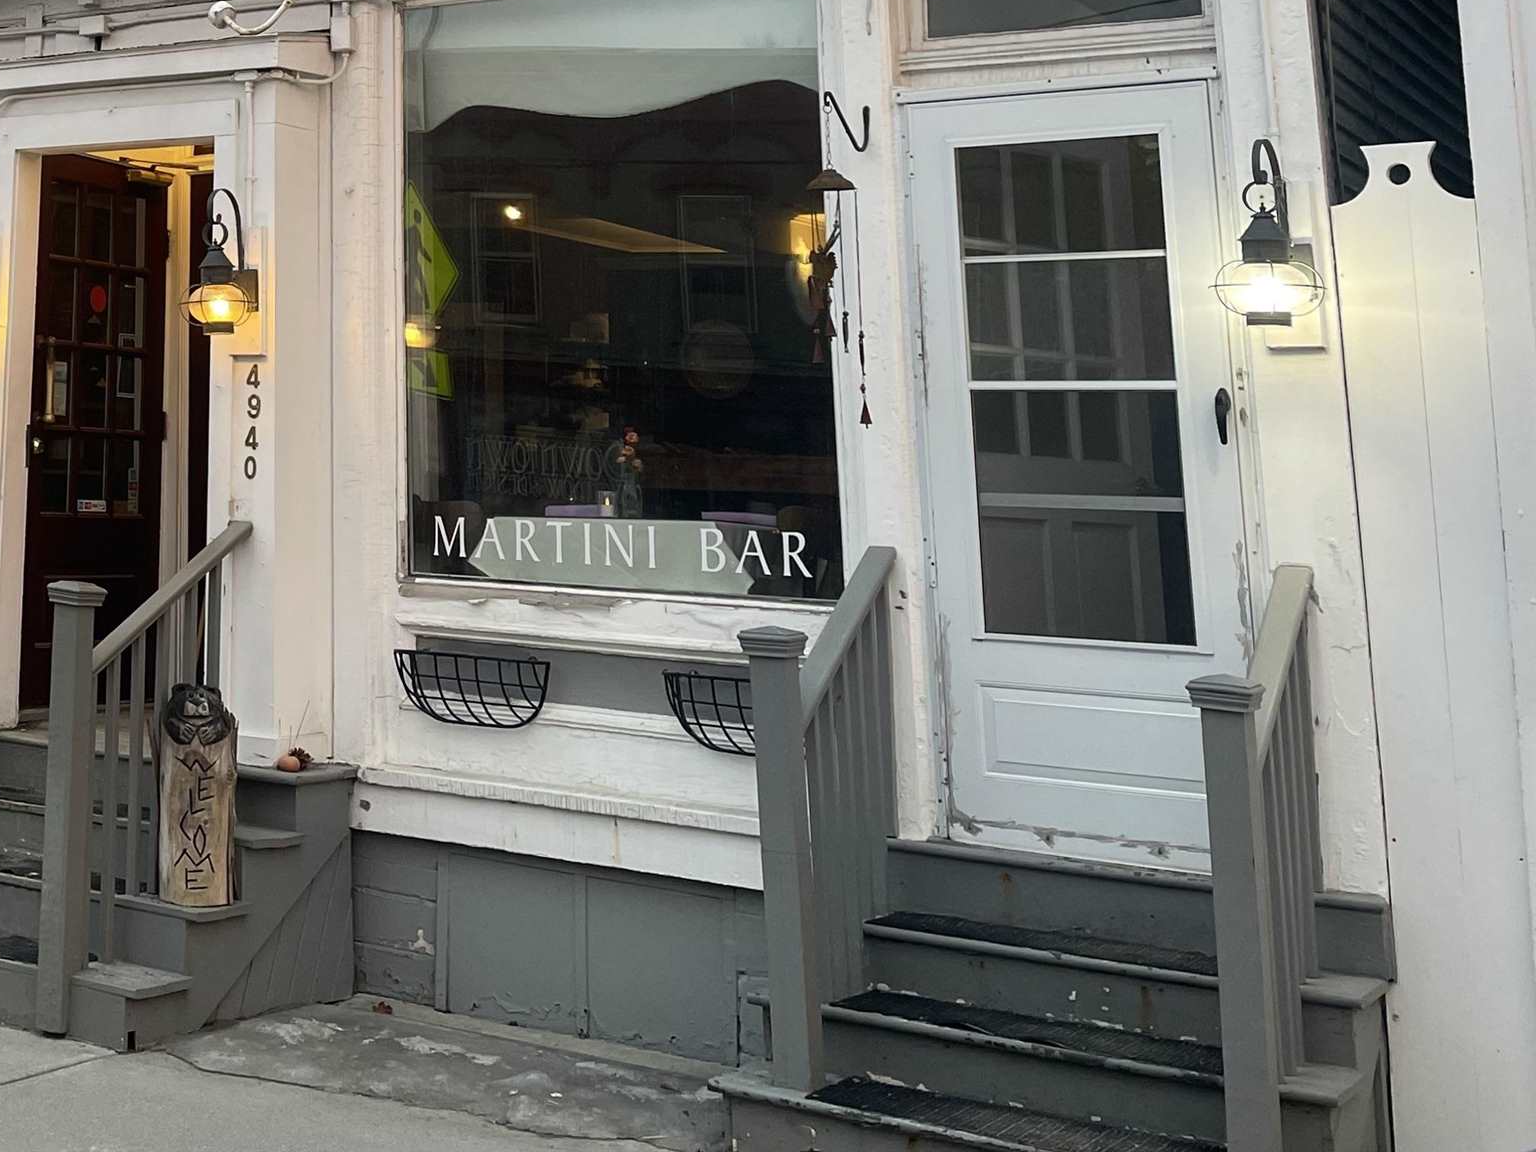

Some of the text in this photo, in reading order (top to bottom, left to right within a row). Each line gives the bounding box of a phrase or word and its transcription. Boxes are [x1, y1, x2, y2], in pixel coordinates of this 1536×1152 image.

[244, 363, 262, 480] 4940
[432, 515, 814, 578] MARTINI BAR
[174, 755, 219, 891] WELCOME
